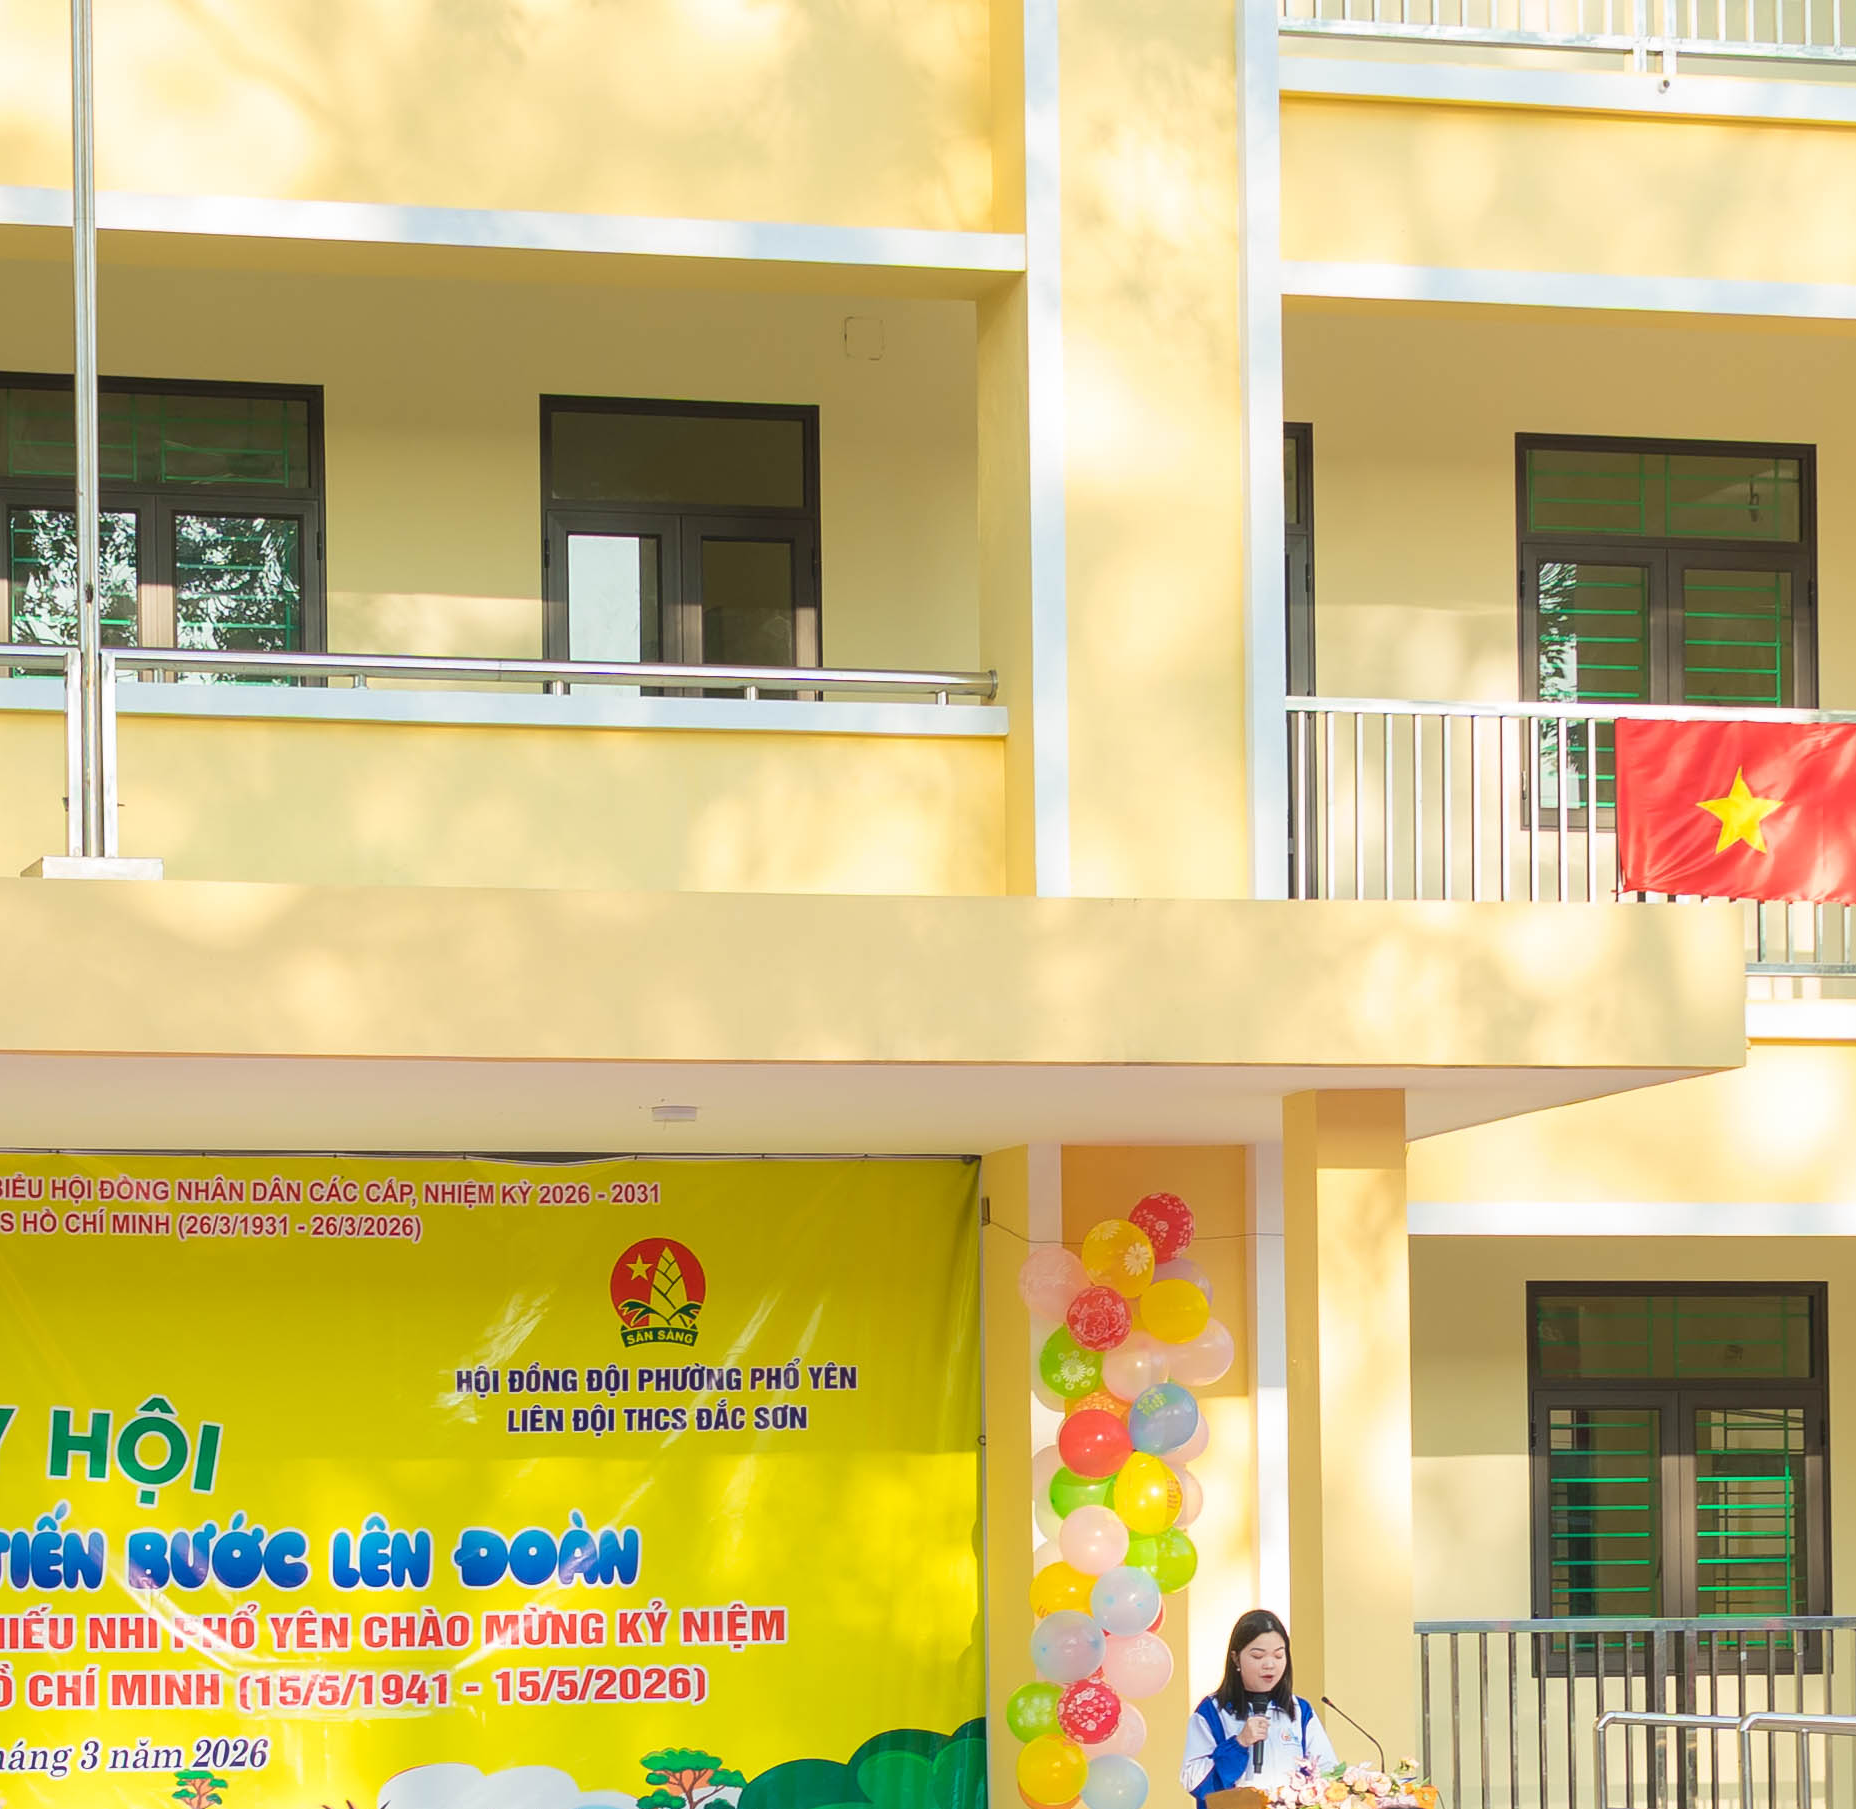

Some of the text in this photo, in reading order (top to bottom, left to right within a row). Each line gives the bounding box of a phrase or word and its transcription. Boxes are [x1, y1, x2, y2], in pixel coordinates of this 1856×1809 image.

[50, 1173, 93, 1204] HỘI
[98, 1174, 170, 1200] ĐỒNG
[177, 1174, 244, 1200] NHÂN
[252, 1175, 302, 1201] DÂN
[308, 1175, 361, 1201] CÁC
[364, 1176, 416, 1207] CẤP,
[424, 1177, 495, 1208] NHIỆM
[500, 1177, 532, 1203] KỲ
[538, 1183, 590, 1204] 2026
[610, 1183, 659, 1204] 2031
[23, 1208, 58, 1233] HỒ
[64, 1208, 105, 1233] CHÍ
[111, 1214, 171, 1234] MINH
[177, 1215, 287, 1239] (26/3/1931
[311, 1217, 421, 1241] 26/3/2026)
[456, 1359, 856, 1397] HỘI ĐỒNG ĐỘI PHƯỜNG PHỔ YÊN
[508, 1403, 806, 1436] LIÊN ĐỘI THCS ĐẮC SƠN
[49, 1396, 221, 1504] HỘI
[133, 1511, 307, 1589] BƯỚC
[332, 1516, 431, 1588] LÊN
[453, 1512, 639, 1586] ĐOÀN
[89, 1617, 157, 1648] NHI
[176, 1604, 257, 1648] PHỔ
[271, 1610, 348, 1648] YÊN
[364, 1609, 469, 1648] CHÀO
[486, 1608, 603, 1645] MỪNG
[619, 1602, 667, 1643] KỶ
[683, 1604, 784, 1648] NIỆM
[29, 1668, 95, 1706] CHÍ
[112, 1674, 219, 1705] MINH
[240, 1674, 447, 1709] (15/5/1941
[496, 1668, 705, 1701] 15/5/2026)
[81, 1741, 98, 1769] 3
[110, 1743, 181, 1768] năm
[193, 1739, 267, 1767] 2026
